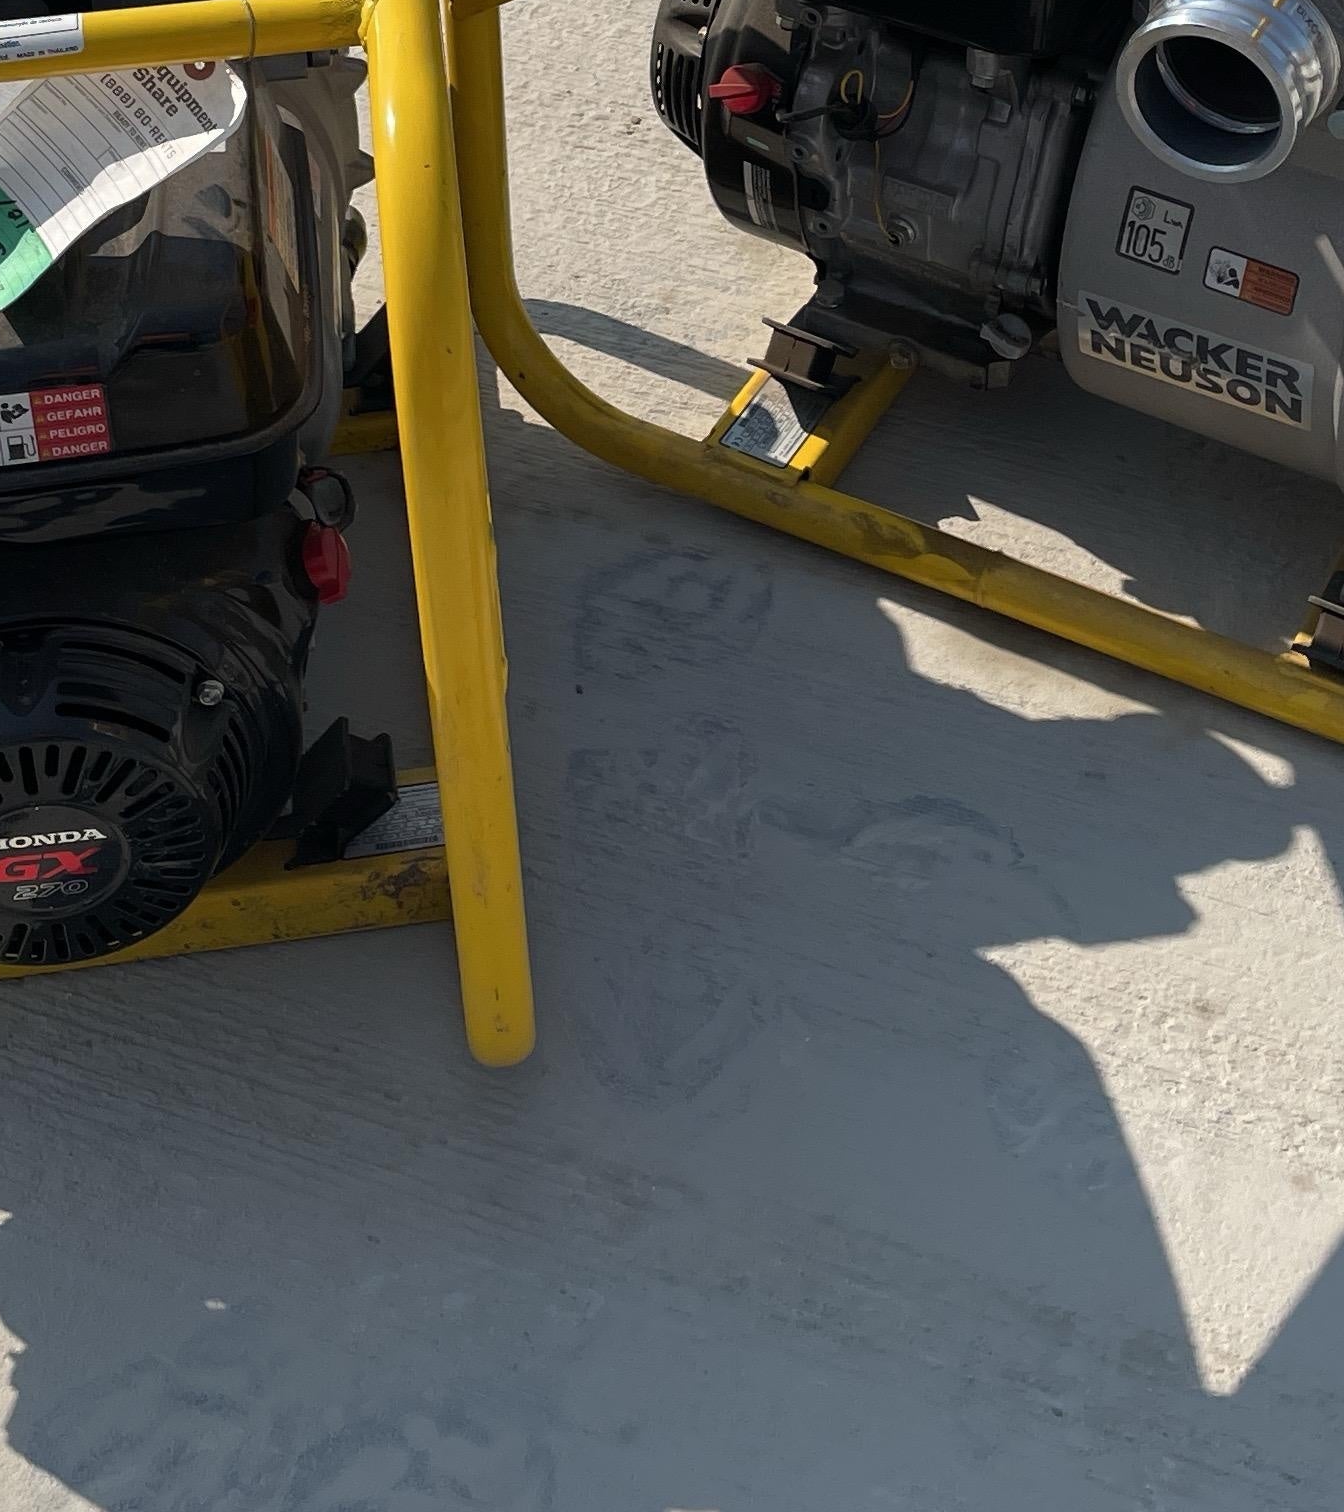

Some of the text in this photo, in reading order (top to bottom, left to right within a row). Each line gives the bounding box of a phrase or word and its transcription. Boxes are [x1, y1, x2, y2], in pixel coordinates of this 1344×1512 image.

[100, 73, 134, 109] (888)
[132, 67, 179, 118] Share
[1125, 220, 1167, 263] 105
[1086, 298, 1304, 397] WACKER
[1091, 329, 1302, 423] NEUSON
[43, 388, 101, 405] DANGER
[46, 406, 103, 422] GEFAHR
[49, 423, 106, 440] PELIGRO
[51, 441, 108, 457] DANGER
[13, 879, 89, 901] 270
